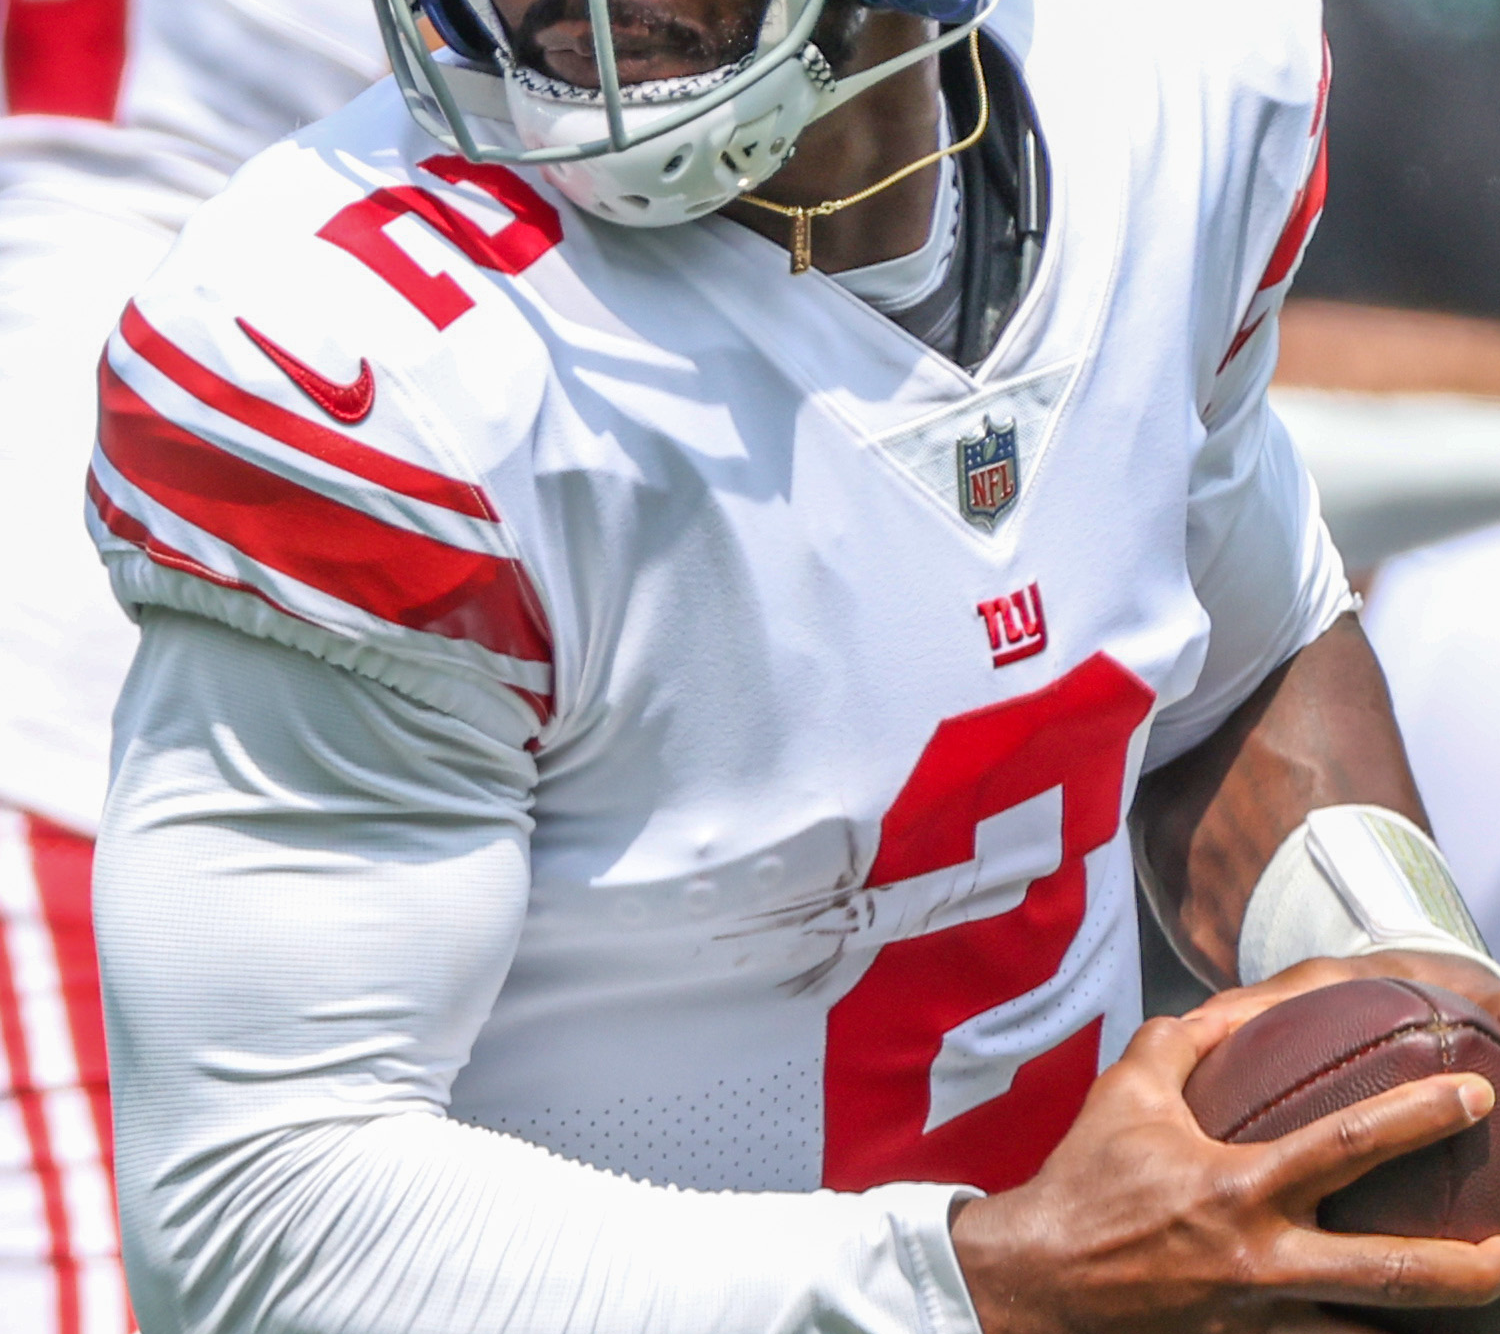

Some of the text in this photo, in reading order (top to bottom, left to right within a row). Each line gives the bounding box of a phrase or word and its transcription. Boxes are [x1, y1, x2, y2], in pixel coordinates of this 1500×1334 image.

[313, 152, 565, 333] 2
[970, 463, 1016, 508] NFL
[822, 651, 1157, 1189] 2
